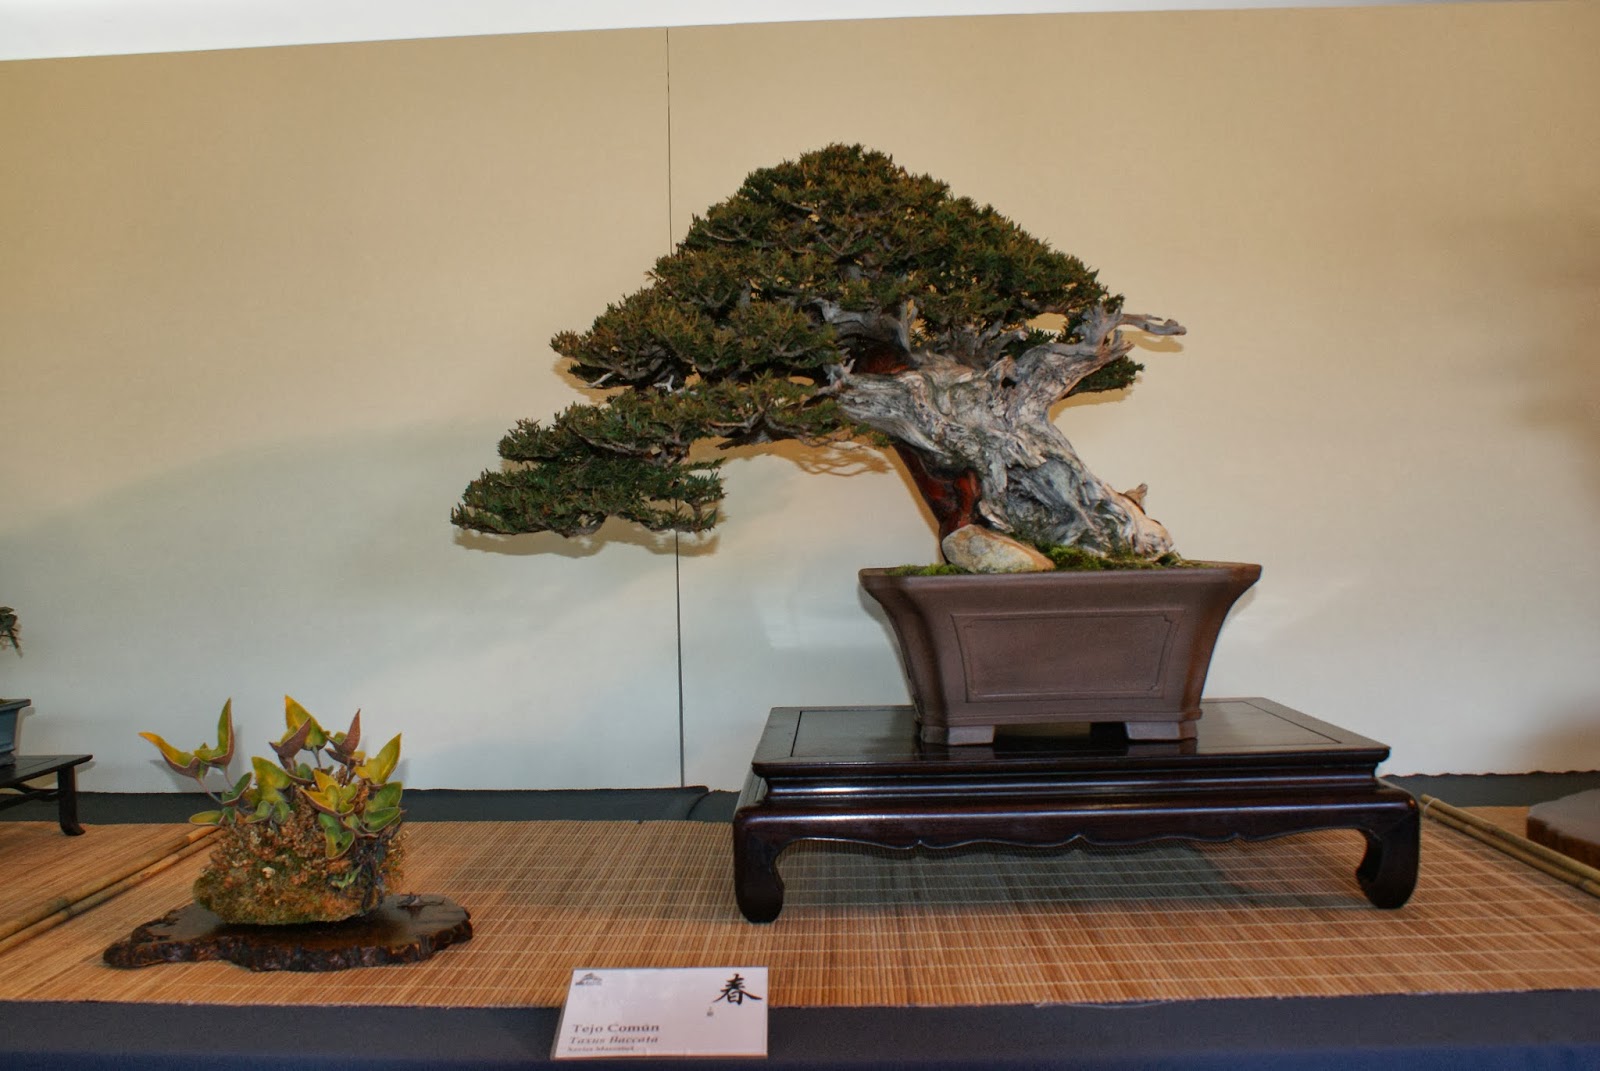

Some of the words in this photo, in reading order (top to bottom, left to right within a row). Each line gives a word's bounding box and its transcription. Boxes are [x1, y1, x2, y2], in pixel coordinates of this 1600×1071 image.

[713, 973, 763, 1005] 春
[573, 1024, 604, 1034] Tejo
[607, 1022, 660, 1032] Común
[570, 1036, 605, 1044] Taxus
